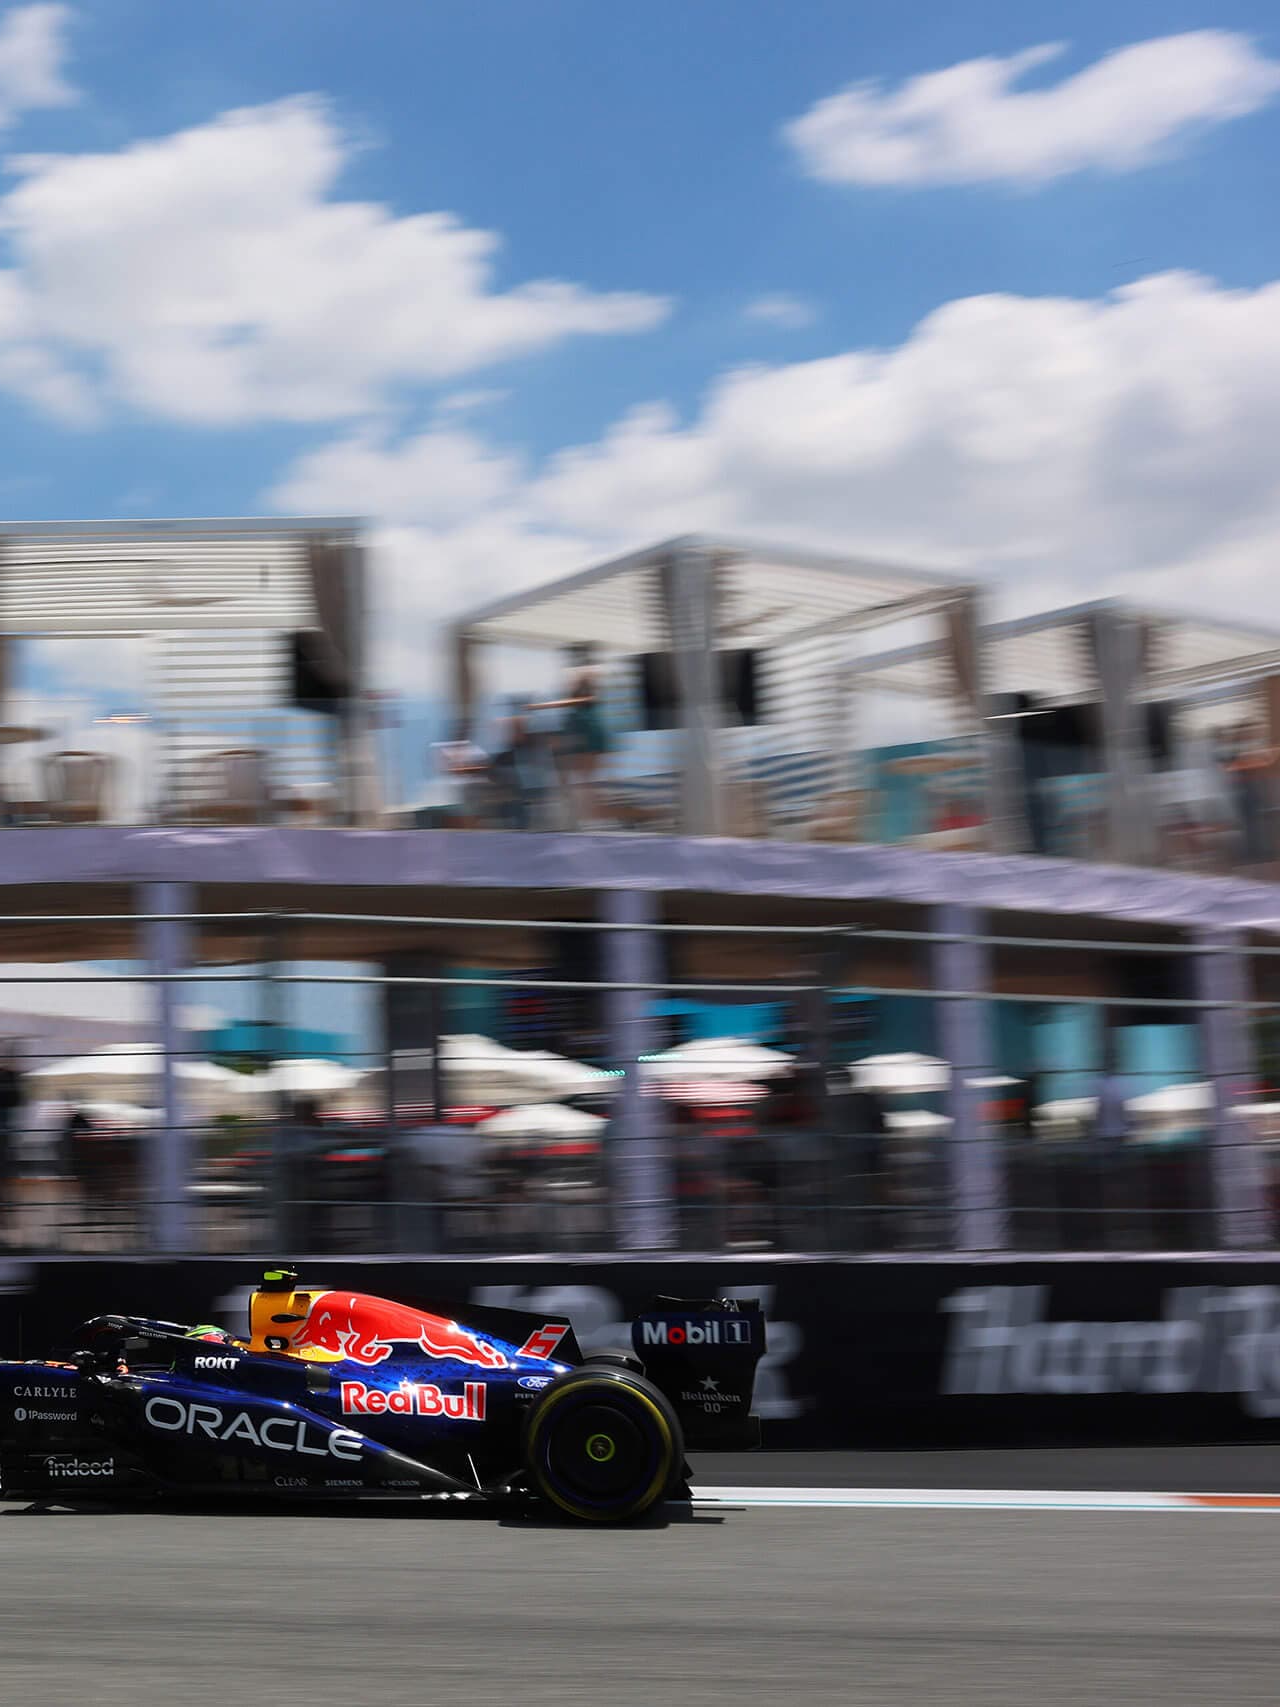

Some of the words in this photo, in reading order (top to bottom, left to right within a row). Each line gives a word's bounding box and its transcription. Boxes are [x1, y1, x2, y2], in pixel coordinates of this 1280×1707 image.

[642, 1321, 720, 1344] Mobil
[515, 1324, 570, 1360] 6
[195, 1356, 240, 1369] ROKT
[14, 1386, 77, 1398] CARLYLE
[681, 1391, 741, 1403] Heineken
[341, 1381, 413, 1415] Red
[417, 1382, 487, 1421] Bull
[28, 1410, 77, 1421] 1Password
[145, 1397, 364, 1462] ORACLE
[44, 1456, 114, 1477] indeed
[274, 1476, 309, 1487] CLEAR
[325, 1479, 364, 1487] SIEMENS
